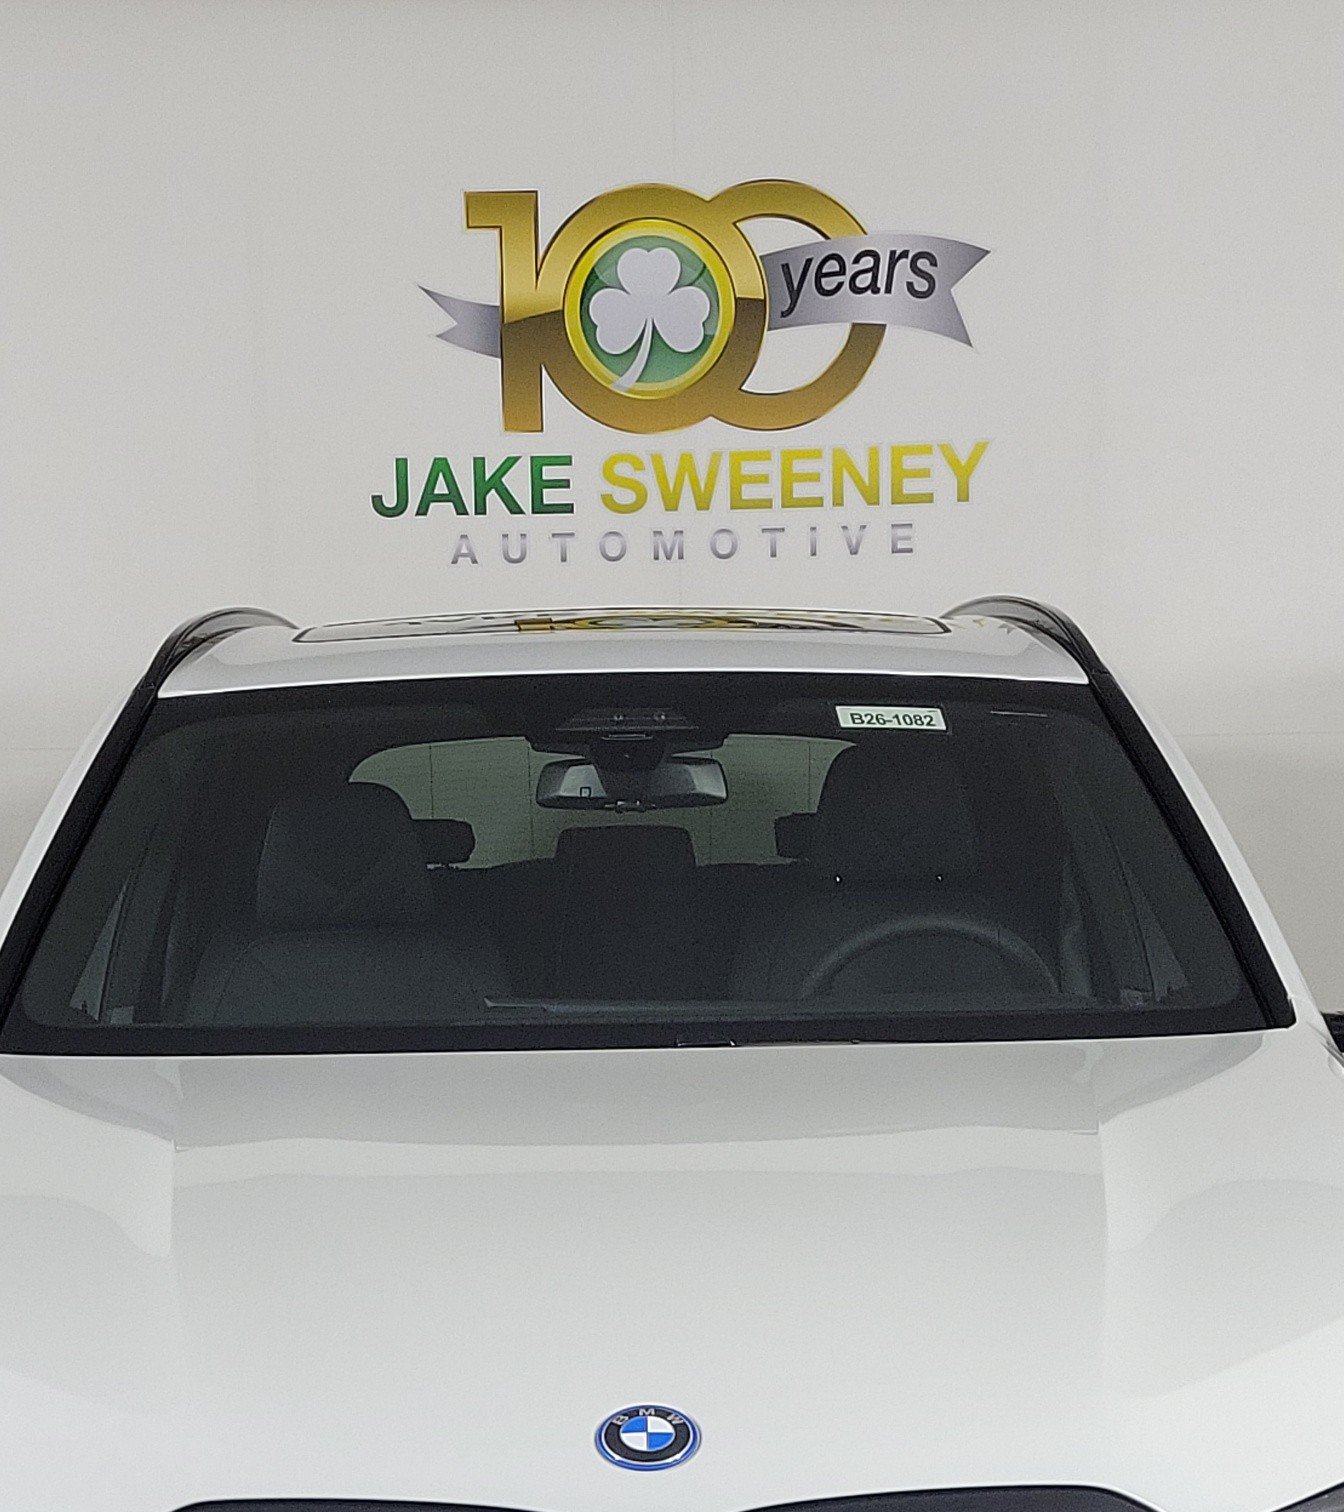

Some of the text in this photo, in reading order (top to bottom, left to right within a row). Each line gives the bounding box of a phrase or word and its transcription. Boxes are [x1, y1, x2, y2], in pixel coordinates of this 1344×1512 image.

[462, 177, 940, 434] 100 years
[370, 440, 990, 517] JAKE SWEENEY
[450, 523, 915, 564] AUTOMOTIVE
[849, 712, 937, 727] B26-1082
[612, 1408, 684, 1425] BMW
